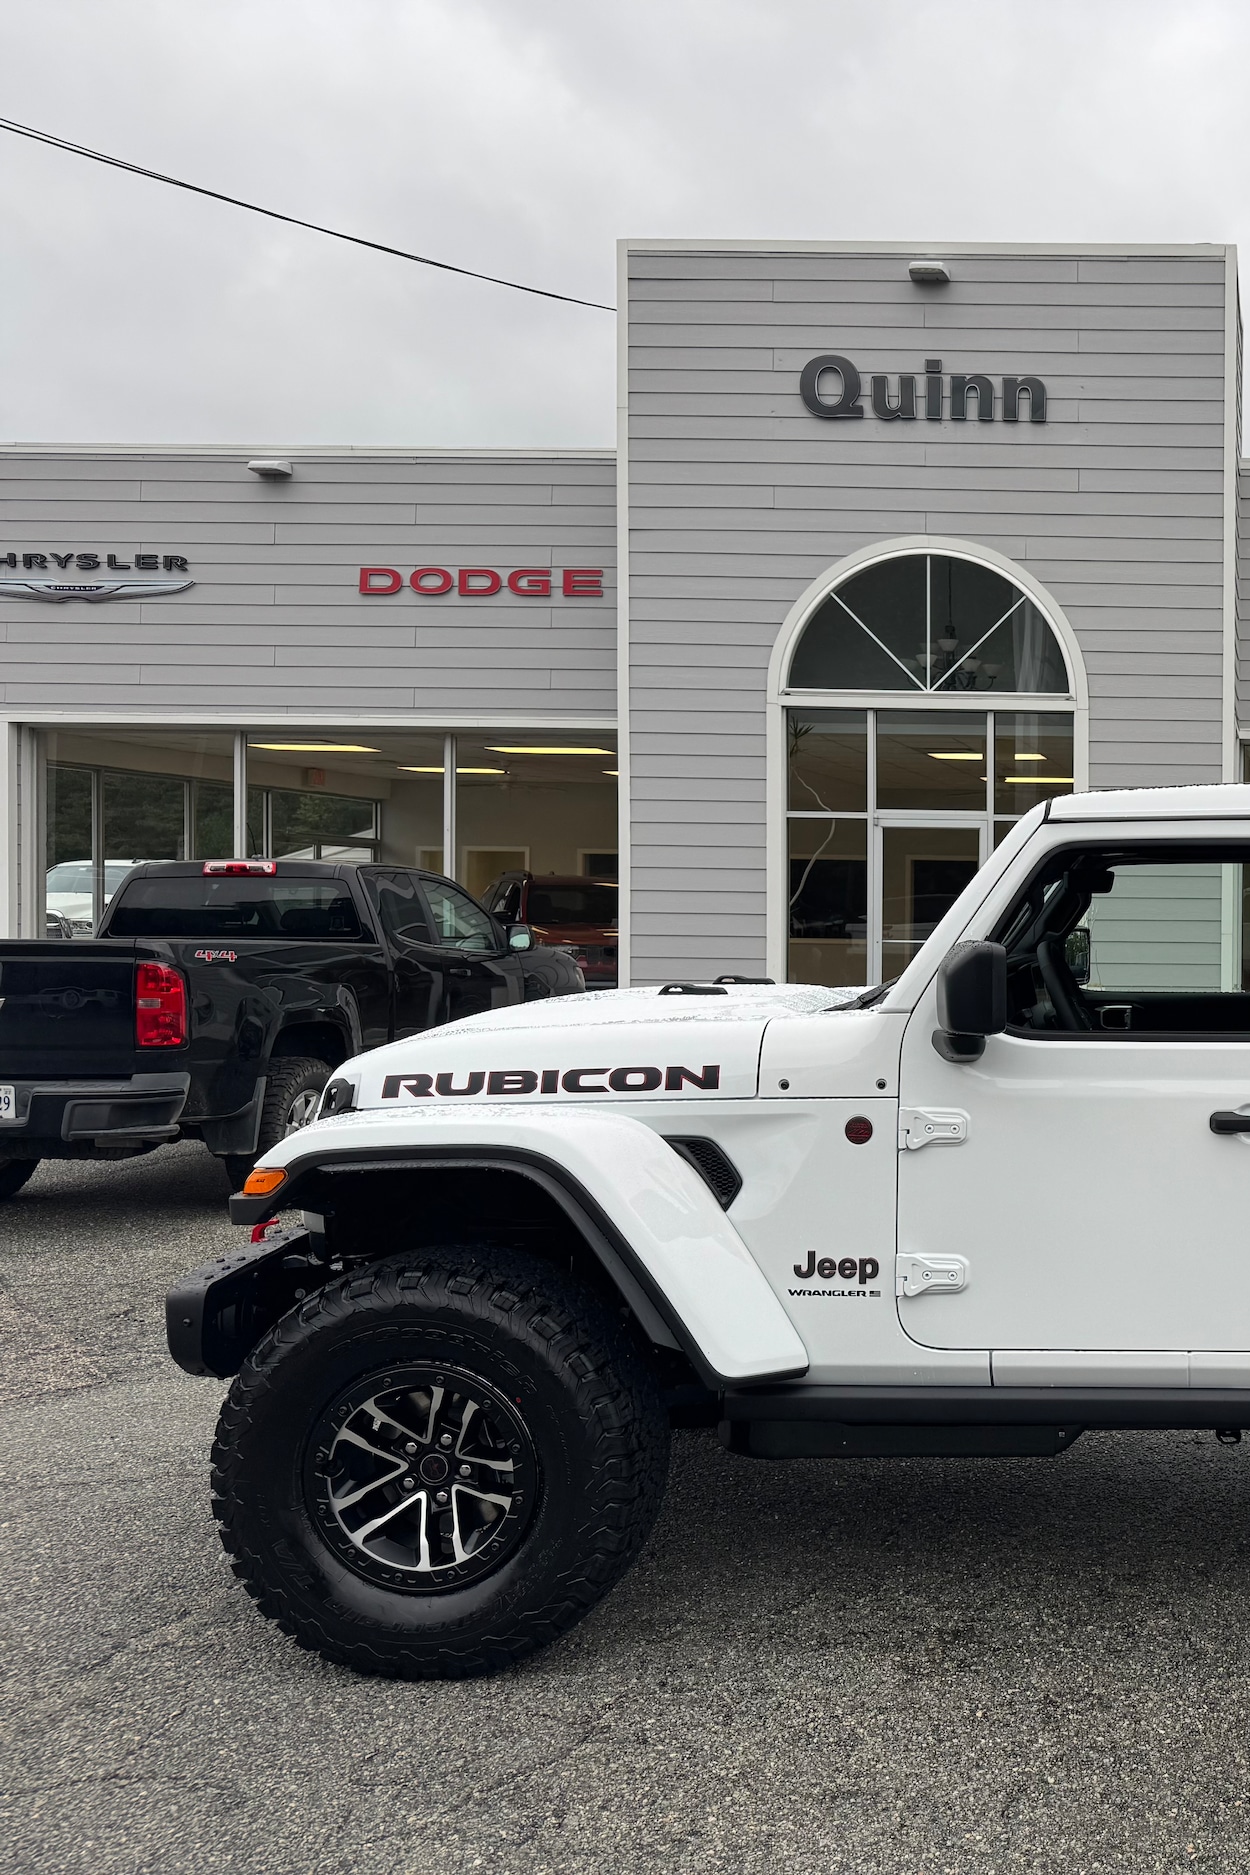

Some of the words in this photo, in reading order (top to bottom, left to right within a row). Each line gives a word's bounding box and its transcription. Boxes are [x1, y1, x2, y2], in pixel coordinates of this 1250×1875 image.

[800, 354, 1047, 422] Quinn
[359, 567, 604, 597] DODGE
[381, 1064, 721, 1099] RUBICON
[793, 1250, 880, 1285] Jeep
[787, 1289, 867, 1298] WRANGLER
